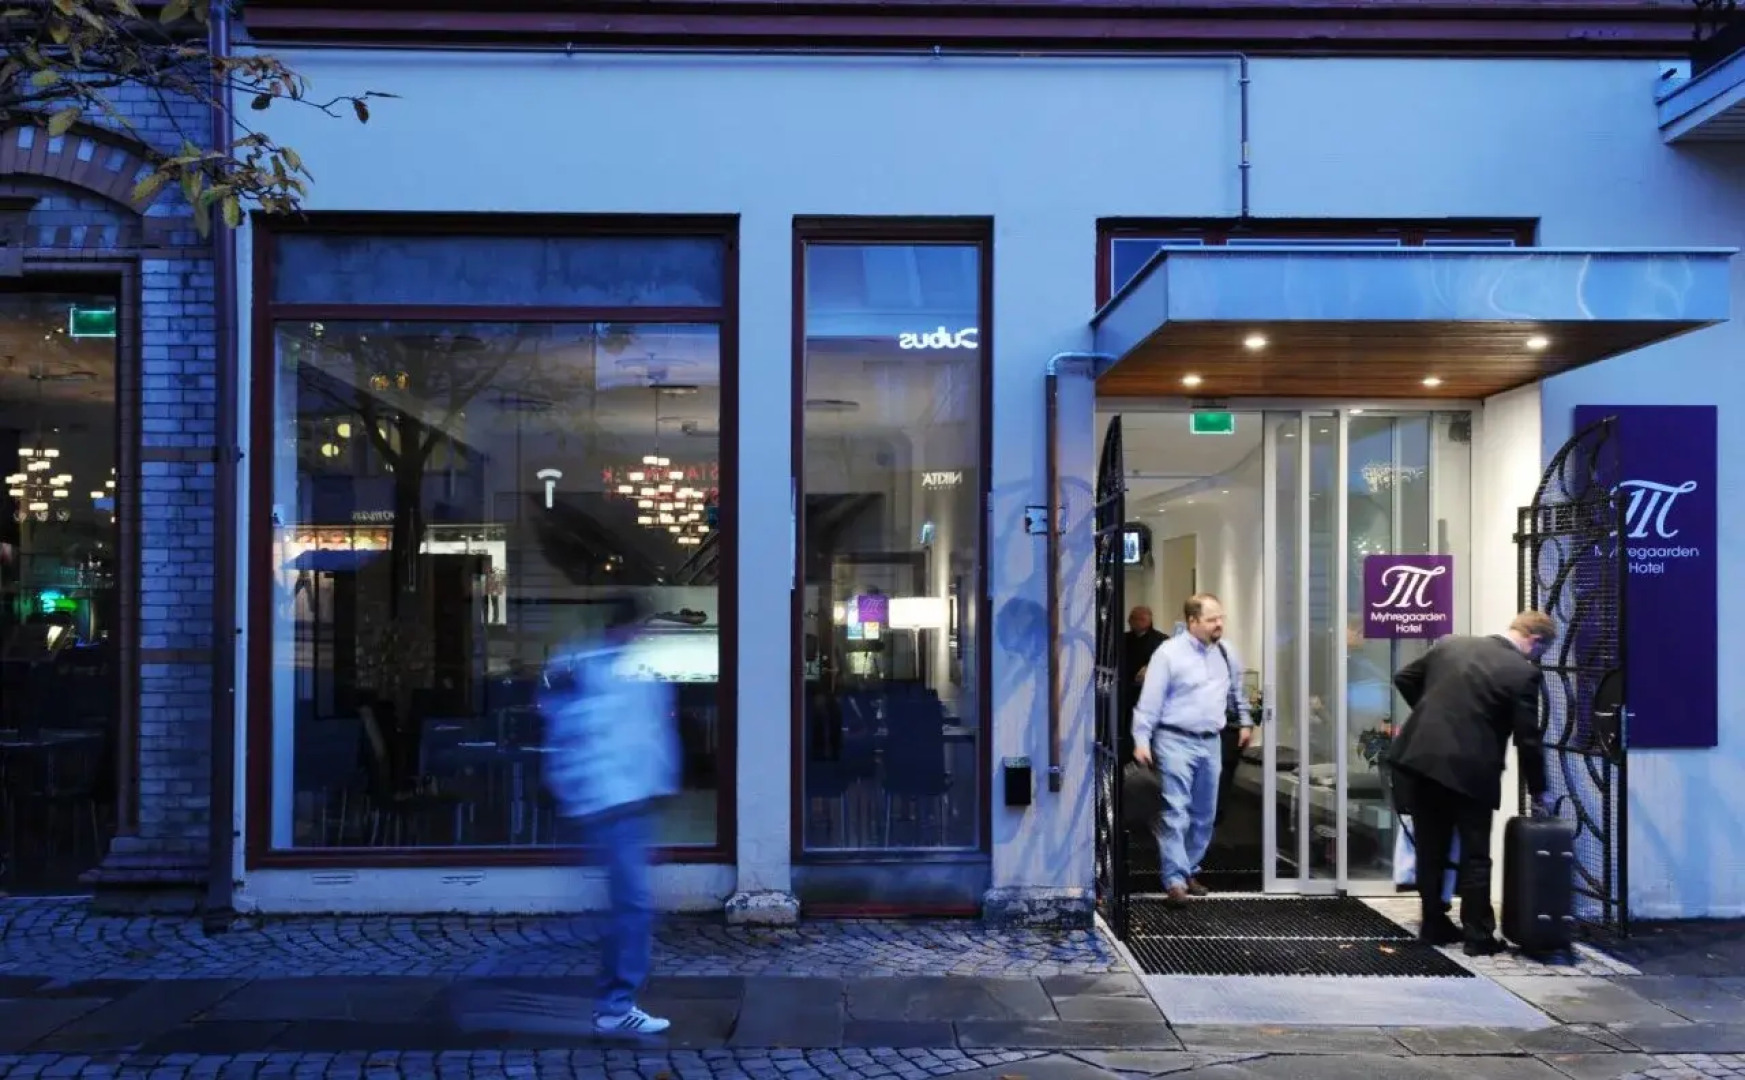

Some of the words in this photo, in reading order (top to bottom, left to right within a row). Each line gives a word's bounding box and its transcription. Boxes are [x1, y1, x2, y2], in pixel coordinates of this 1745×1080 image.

[1628, 562, 1664, 574] Hotel
[1370, 612, 1446, 623] Myhregaarden
[1395, 623, 1422, 633] Hotel
